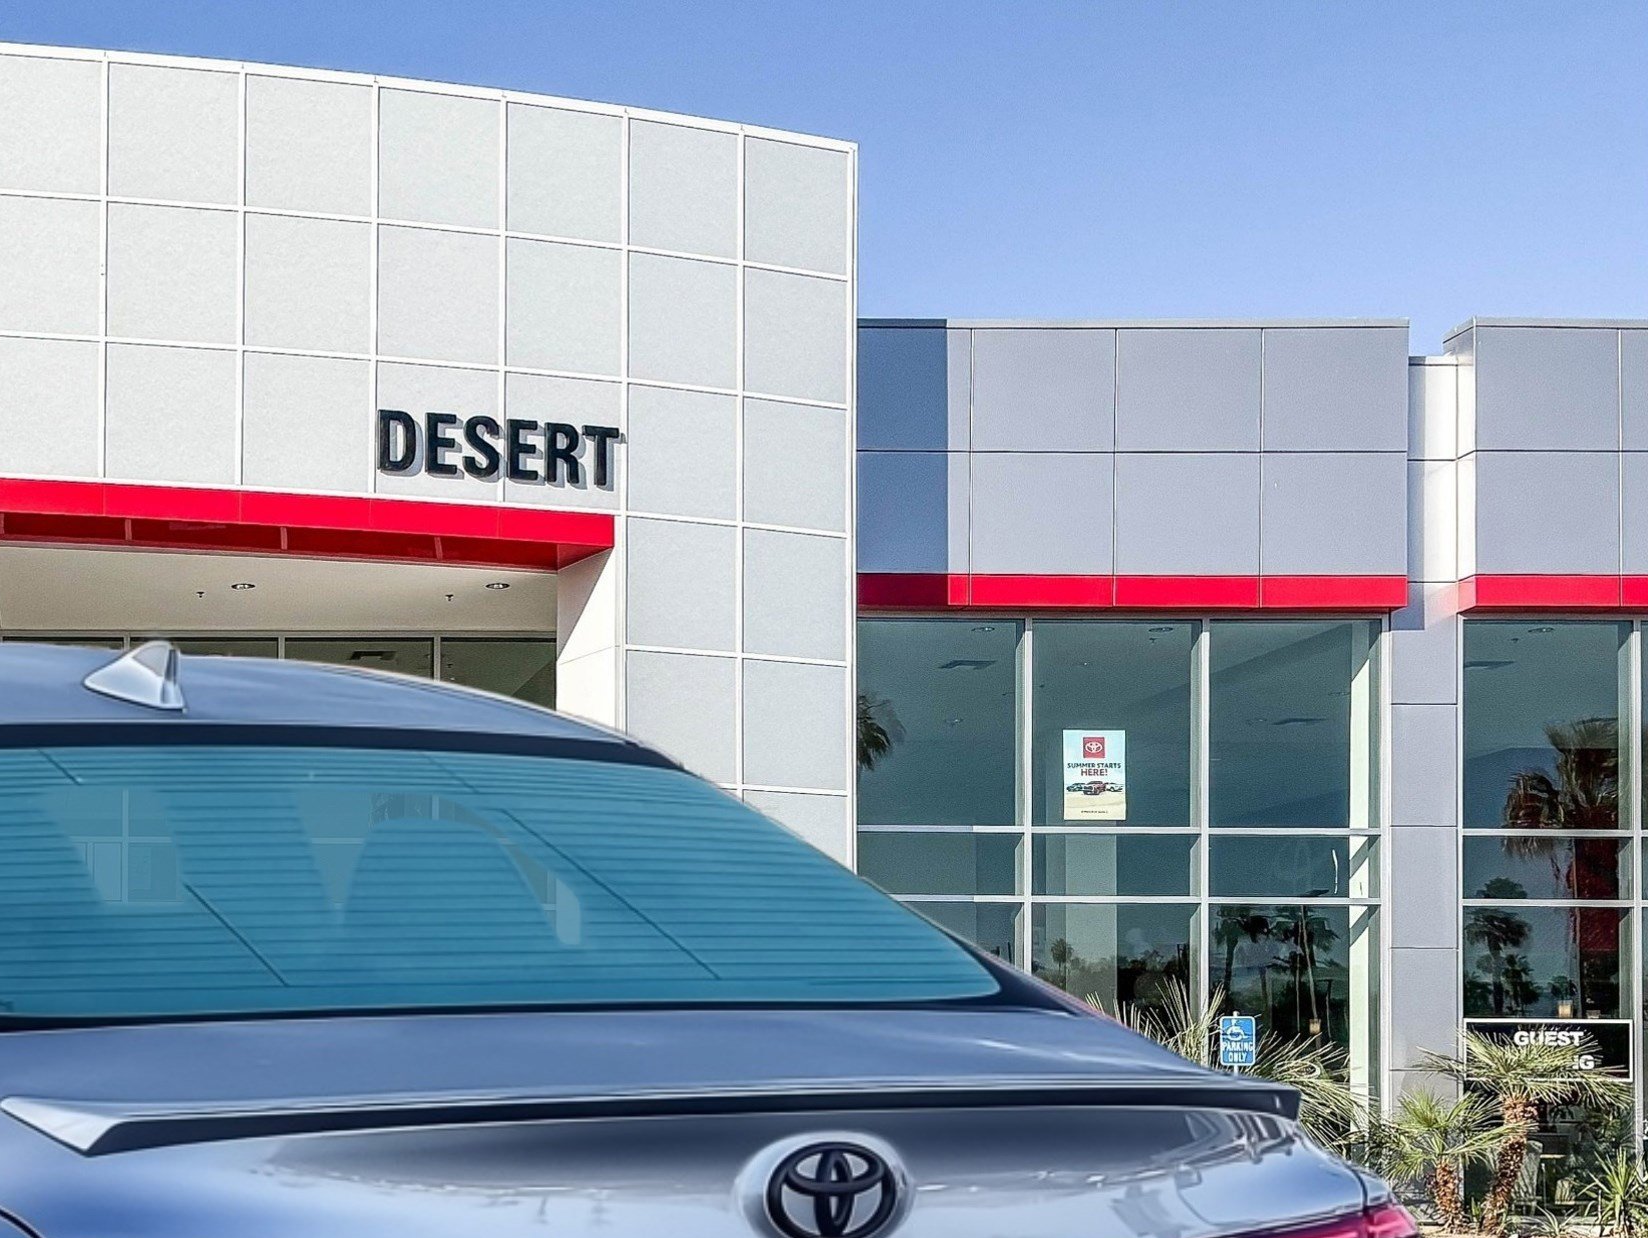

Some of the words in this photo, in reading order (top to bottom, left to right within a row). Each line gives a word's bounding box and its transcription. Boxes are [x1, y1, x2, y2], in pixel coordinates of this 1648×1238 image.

[377, 409, 620, 487] DESERT
[1080, 768, 1108, 776] HERE!
[1513, 1030, 1585, 1047] GUEST
[1222, 1041, 1253, 1052] PARKING
[1228, 1052, 1247, 1062] ONLY
